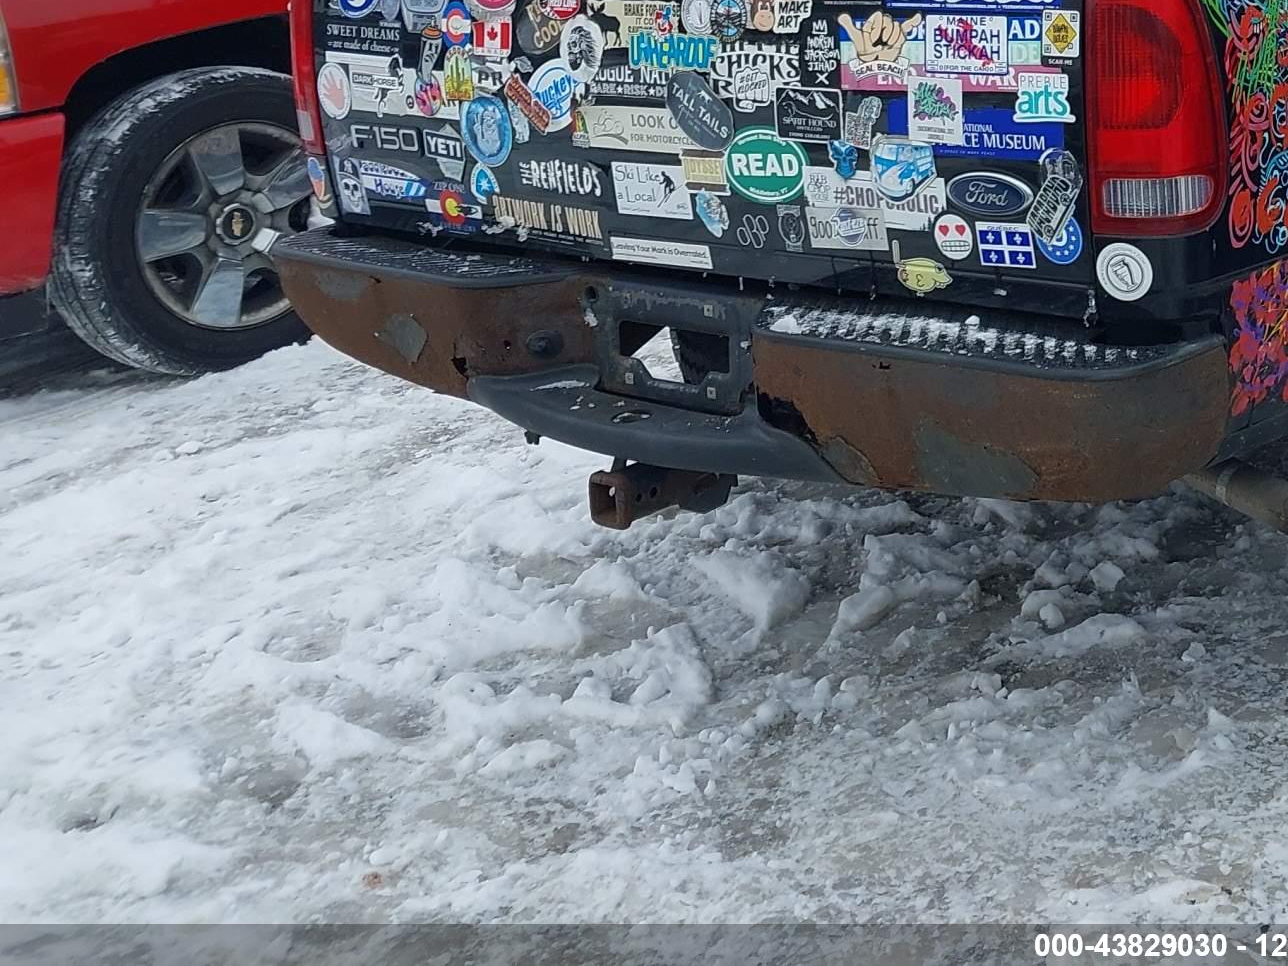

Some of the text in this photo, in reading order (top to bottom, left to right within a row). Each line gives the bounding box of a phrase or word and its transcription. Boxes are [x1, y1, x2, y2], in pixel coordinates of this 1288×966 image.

[624, 3, 644, 16] BRAKE
[778, 1, 809, 15] MAKE
[777, 14, 800, 29] ART
[946, 16, 987, 26] MAINE
[326, 24, 400, 41] SWEET DREAMS
[933, 27, 1001, 45] BUMPAH
[361, 40, 371, 50] of
[371, 42, 391, 53] cheese
[933, 43, 1001, 61] STICKAH
[807, 61, 837, 72] JIHAD
[855, 63, 904, 76] SEAL BEACH
[353, 74, 398, 87] DARK HORSE
[1019, 75, 1067, 90] PREBLE
[623, 84, 648, 96] RISK
[1017, 87, 1069, 117] arts
[672, 82, 730, 139] TALL TAILS
[631, 114, 665, 129] LOOK
[782, 116, 837, 128] SPIRIT HOUND
[630, 134, 645, 142] FOR
[983, 134, 1045, 150] MUSEUM
[427, 135, 462, 158] YETI
[730, 153, 800, 177] READ
[615, 164, 662, 183] Ski Like
[617, 185, 657, 203] a Local
[965, 181, 1009, 206] Ford
[550, 203, 564, 234] IS
[564, 206, 603, 240] WORK
[613, 242, 636, 254] Leaving
[636, 244, 651, 253] Your
